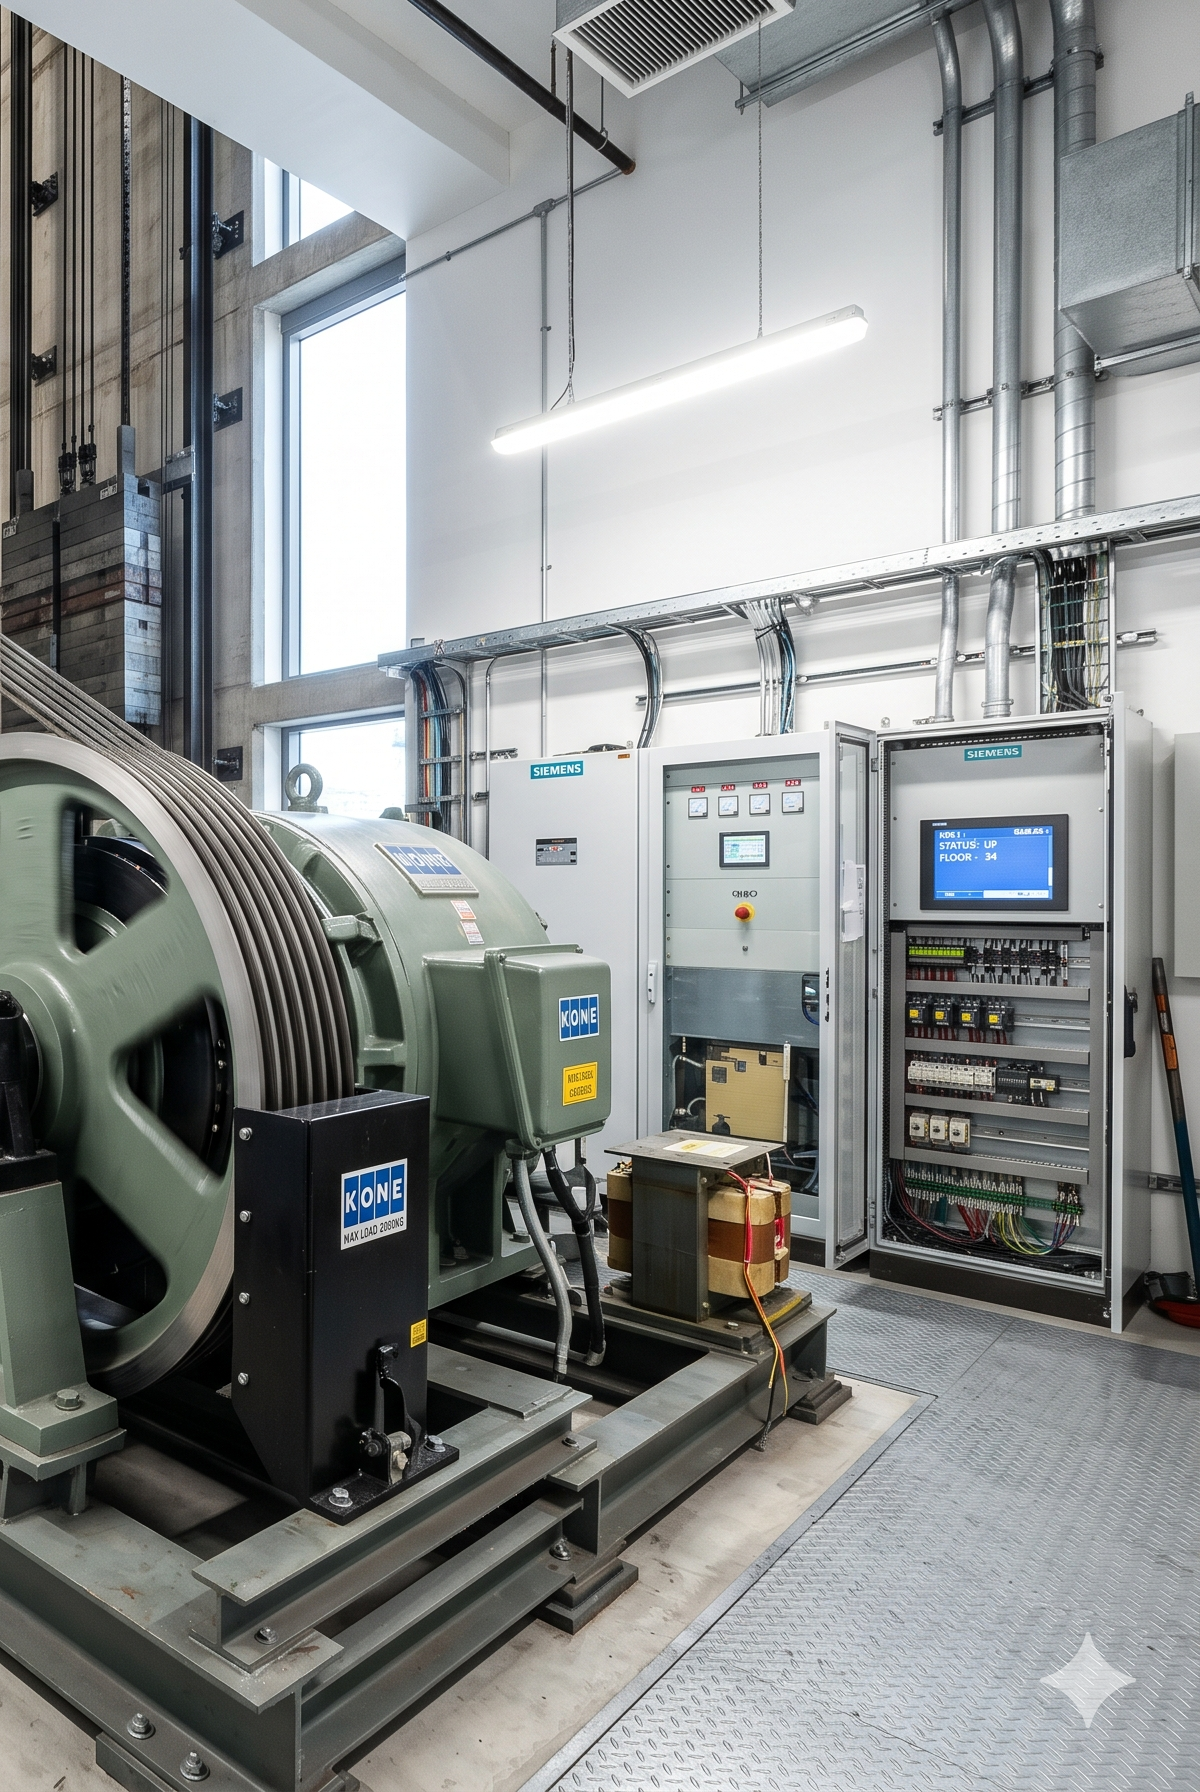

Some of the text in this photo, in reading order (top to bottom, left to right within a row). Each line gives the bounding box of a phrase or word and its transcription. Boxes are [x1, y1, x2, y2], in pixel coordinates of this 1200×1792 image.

[967, 747, 1019, 759] SIEMENS
[533, 763, 581, 777] SIEMENS
[983, 840, 997, 849] UP
[939, 853, 972, 862] FLOOR
[984, 852, 997, 861] 34
[561, 1006, 597, 1028] KONE
[345, 1177, 403, 1214] KONE
[343, 1230, 359, 1245] MAX
[360, 1224, 378, 1240] LOAD
